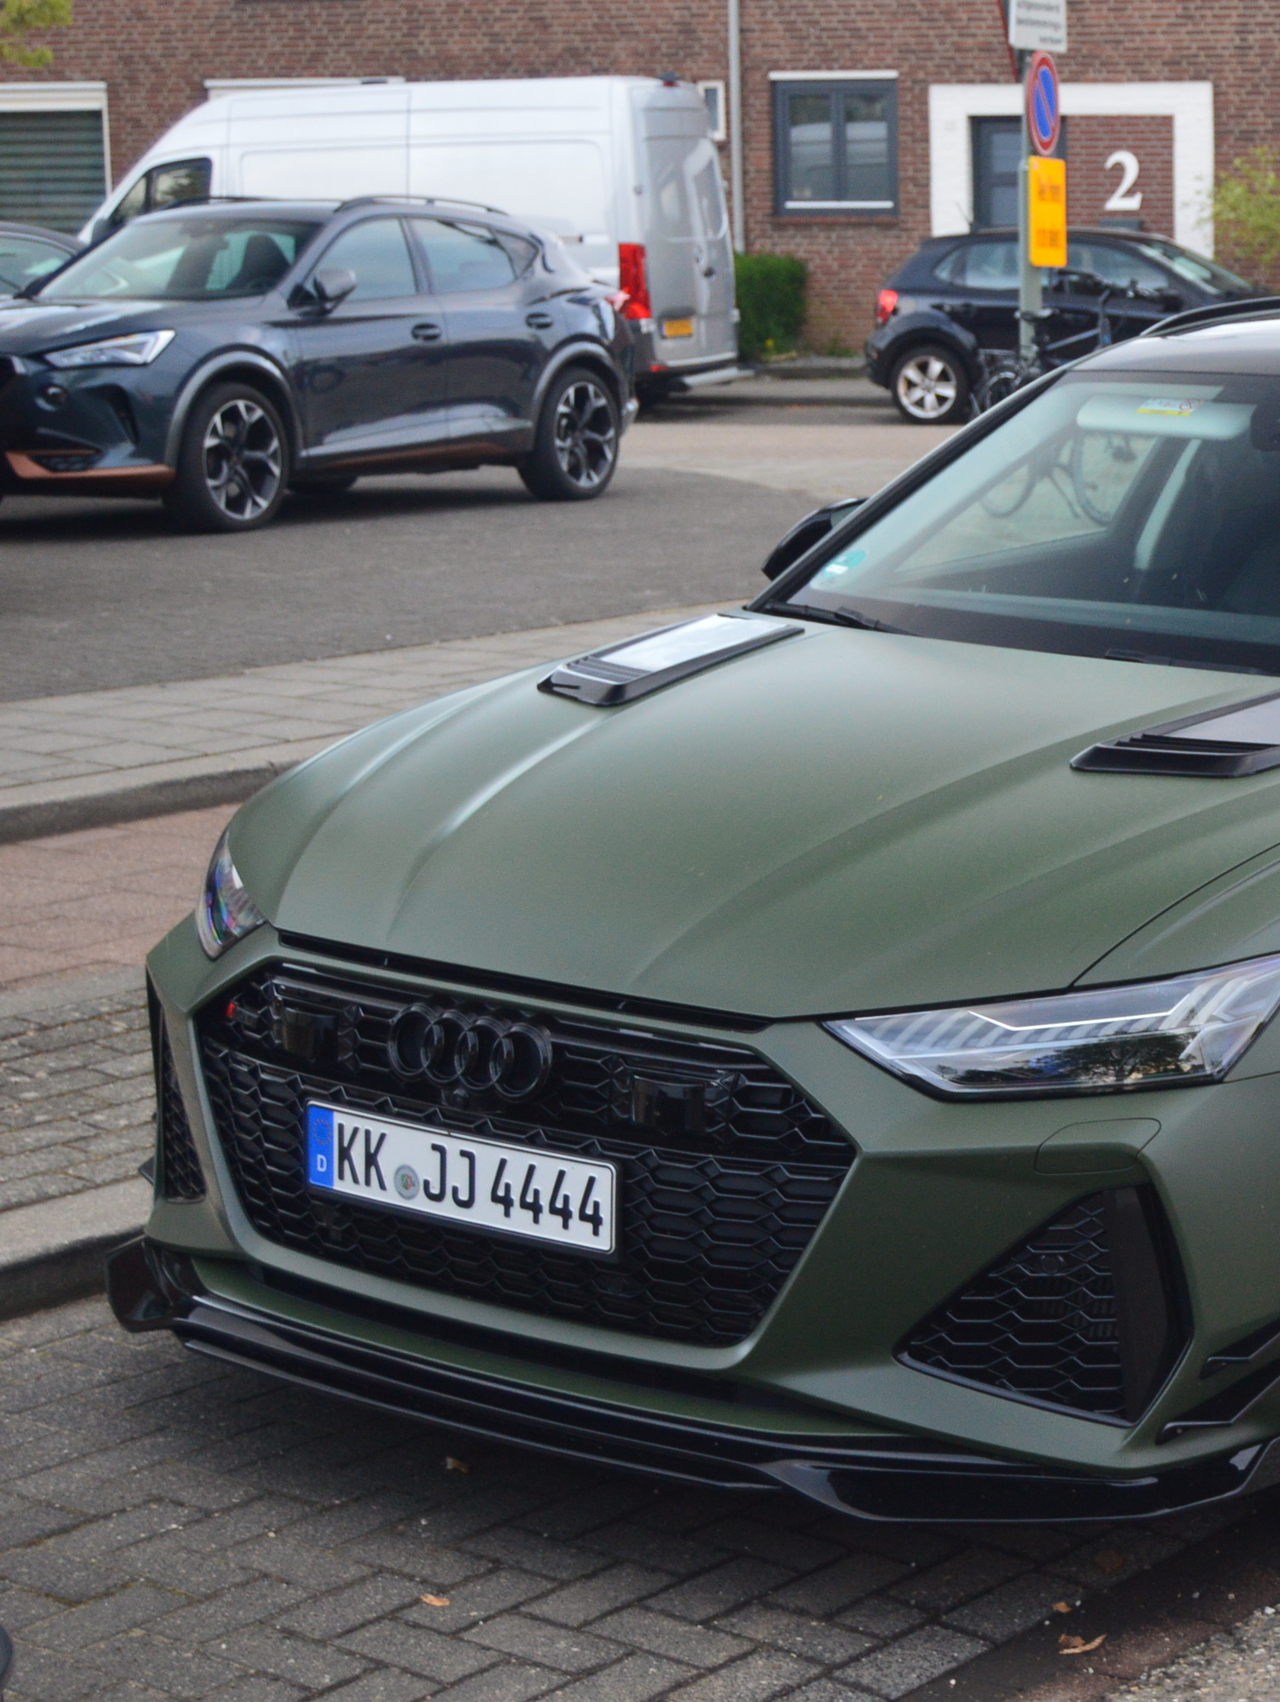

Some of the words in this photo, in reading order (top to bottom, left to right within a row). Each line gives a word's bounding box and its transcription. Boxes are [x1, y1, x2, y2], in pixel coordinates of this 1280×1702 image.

[1104, 150, 1143, 211] 2
[316, 1154, 327, 1172] D
[337, 1121, 388, 1191] KK
[423, 1142, 476, 1209] JJ
[490, 1157, 603, 1237] 4444
